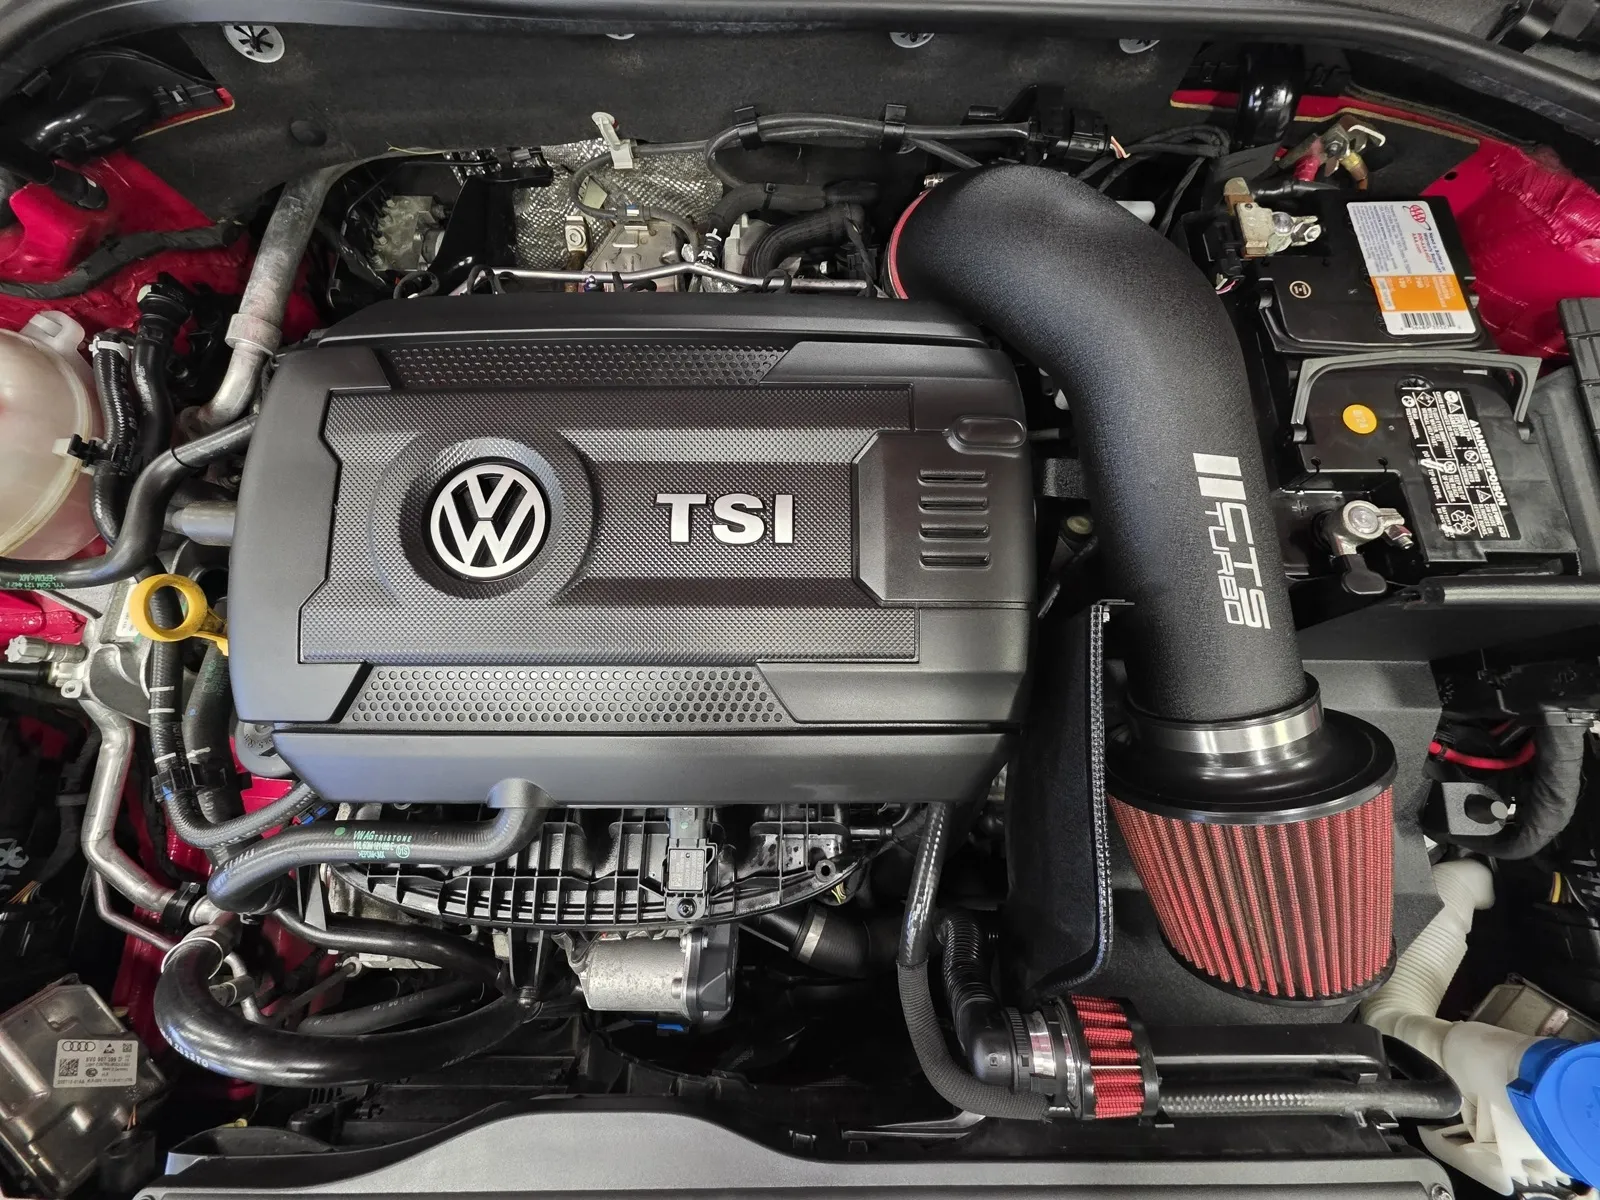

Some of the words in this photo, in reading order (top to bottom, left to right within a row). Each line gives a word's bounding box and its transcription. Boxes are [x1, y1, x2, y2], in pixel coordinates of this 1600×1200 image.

[1409, 205, 1427, 223] AAA
[1471, 426, 1508, 506] DANGER/POISON
[430, 464, 546, 578] VW
[656, 493, 793, 544] TSI
[1205, 502, 1245, 625] TURBO
[1222, 502, 1271, 629] CTS
